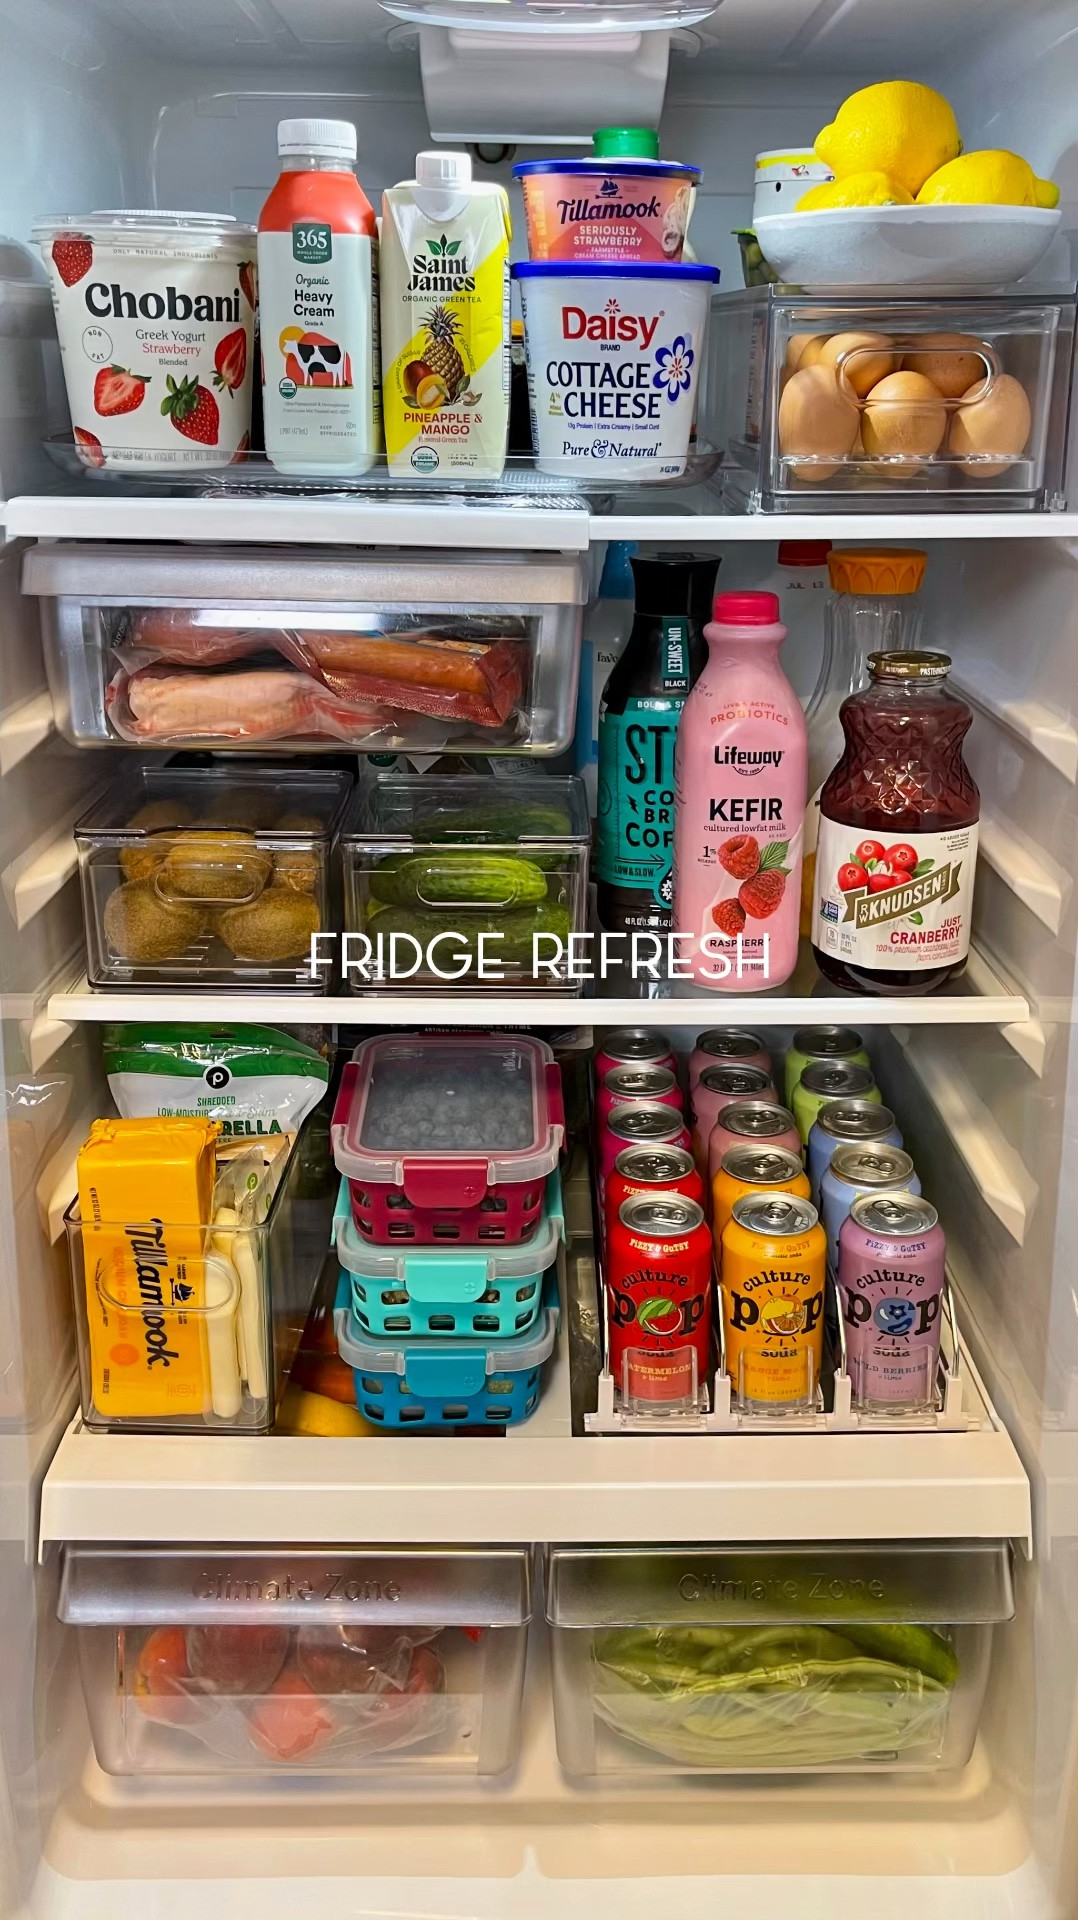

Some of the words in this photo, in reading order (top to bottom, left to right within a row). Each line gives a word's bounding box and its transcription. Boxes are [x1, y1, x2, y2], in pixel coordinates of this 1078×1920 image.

[557, 196, 661, 224] Tillamook
[579, 225, 637, 236] SERIOUSLY
[296, 229, 328, 249] 365
[573, 235, 643, 246] STRAWBERRY
[135, 249, 168, 257] NATURAL
[413, 254, 469, 274] Saint
[295, 273, 330, 288] Organic
[407, 274, 476, 291] James
[85, 282, 241, 323] Chobani
[294, 289, 334, 305] Heavy
[402, 295, 438, 303] ORGANIC
[467, 296, 482, 304] TEA
[293, 303, 335, 318] Cream
[87, 329, 103, 338] NON
[135, 328, 169, 342] Greek
[172, 330, 206, 344] Yogurt
[562, 306, 660, 351] Daisy
[142, 342, 202, 358] Strawberry
[600, 343, 621, 351] BRAND
[91, 352, 106, 361] FAT
[158, 358, 189, 367] Blended
[546, 360, 651, 389] COTTAGE
[563, 391, 662, 419] CHEESE
[403, 412, 471, 423] PINEAPPLE
[474, 413, 483, 424] &
[421, 425, 470, 435] MANGO
[562, 441, 590, 456] Pure
[590, 439, 609, 458] &
[812, 581, 825, 590] 13
[667, 627, 684, 674] UN-SWEET
[664, 679, 687, 688] BLACK
[749, 701, 776, 710] ACTIVE
[710, 709, 789, 726] PROBIOTICS
[625, 723, 677, 785] ST
[714, 745, 782, 768] Lifeway
[643, 789, 674, 806] CO
[644, 808, 670, 824] BR
[708, 798, 784, 822] KEFIR
[625, 821, 674, 848] COF
[703, 823, 740, 833] cultured
[741, 823, 768, 833] lowfat
[768, 822, 787, 832] milk
[868, 873, 942, 921] KNUDSEN
[940, 915, 962, 929] JUST
[709, 937, 771, 948] RASPERR
[890, 926, 961, 945] CRANBERRY
[875, 944, 894, 953] 100%
[196, 1096, 236, 1106] SHREDDED
[217, 1119, 283, 1136] RELLA
[621, 1269, 689, 1290] culture
[743, 1269, 811, 1292] culture
[857, 1269, 926, 1289] culture
[125, 1218, 179, 1367] Tillamook
[628, 1362, 692, 1375] ATERMELON
[648, 1374, 668, 1382] lime
[192, 1572, 315, 1602] Climate
[323, 1572, 402, 1602] Zone
[679, 1573, 799, 1602] Climate
[807, 1572, 885, 1600] Zone
